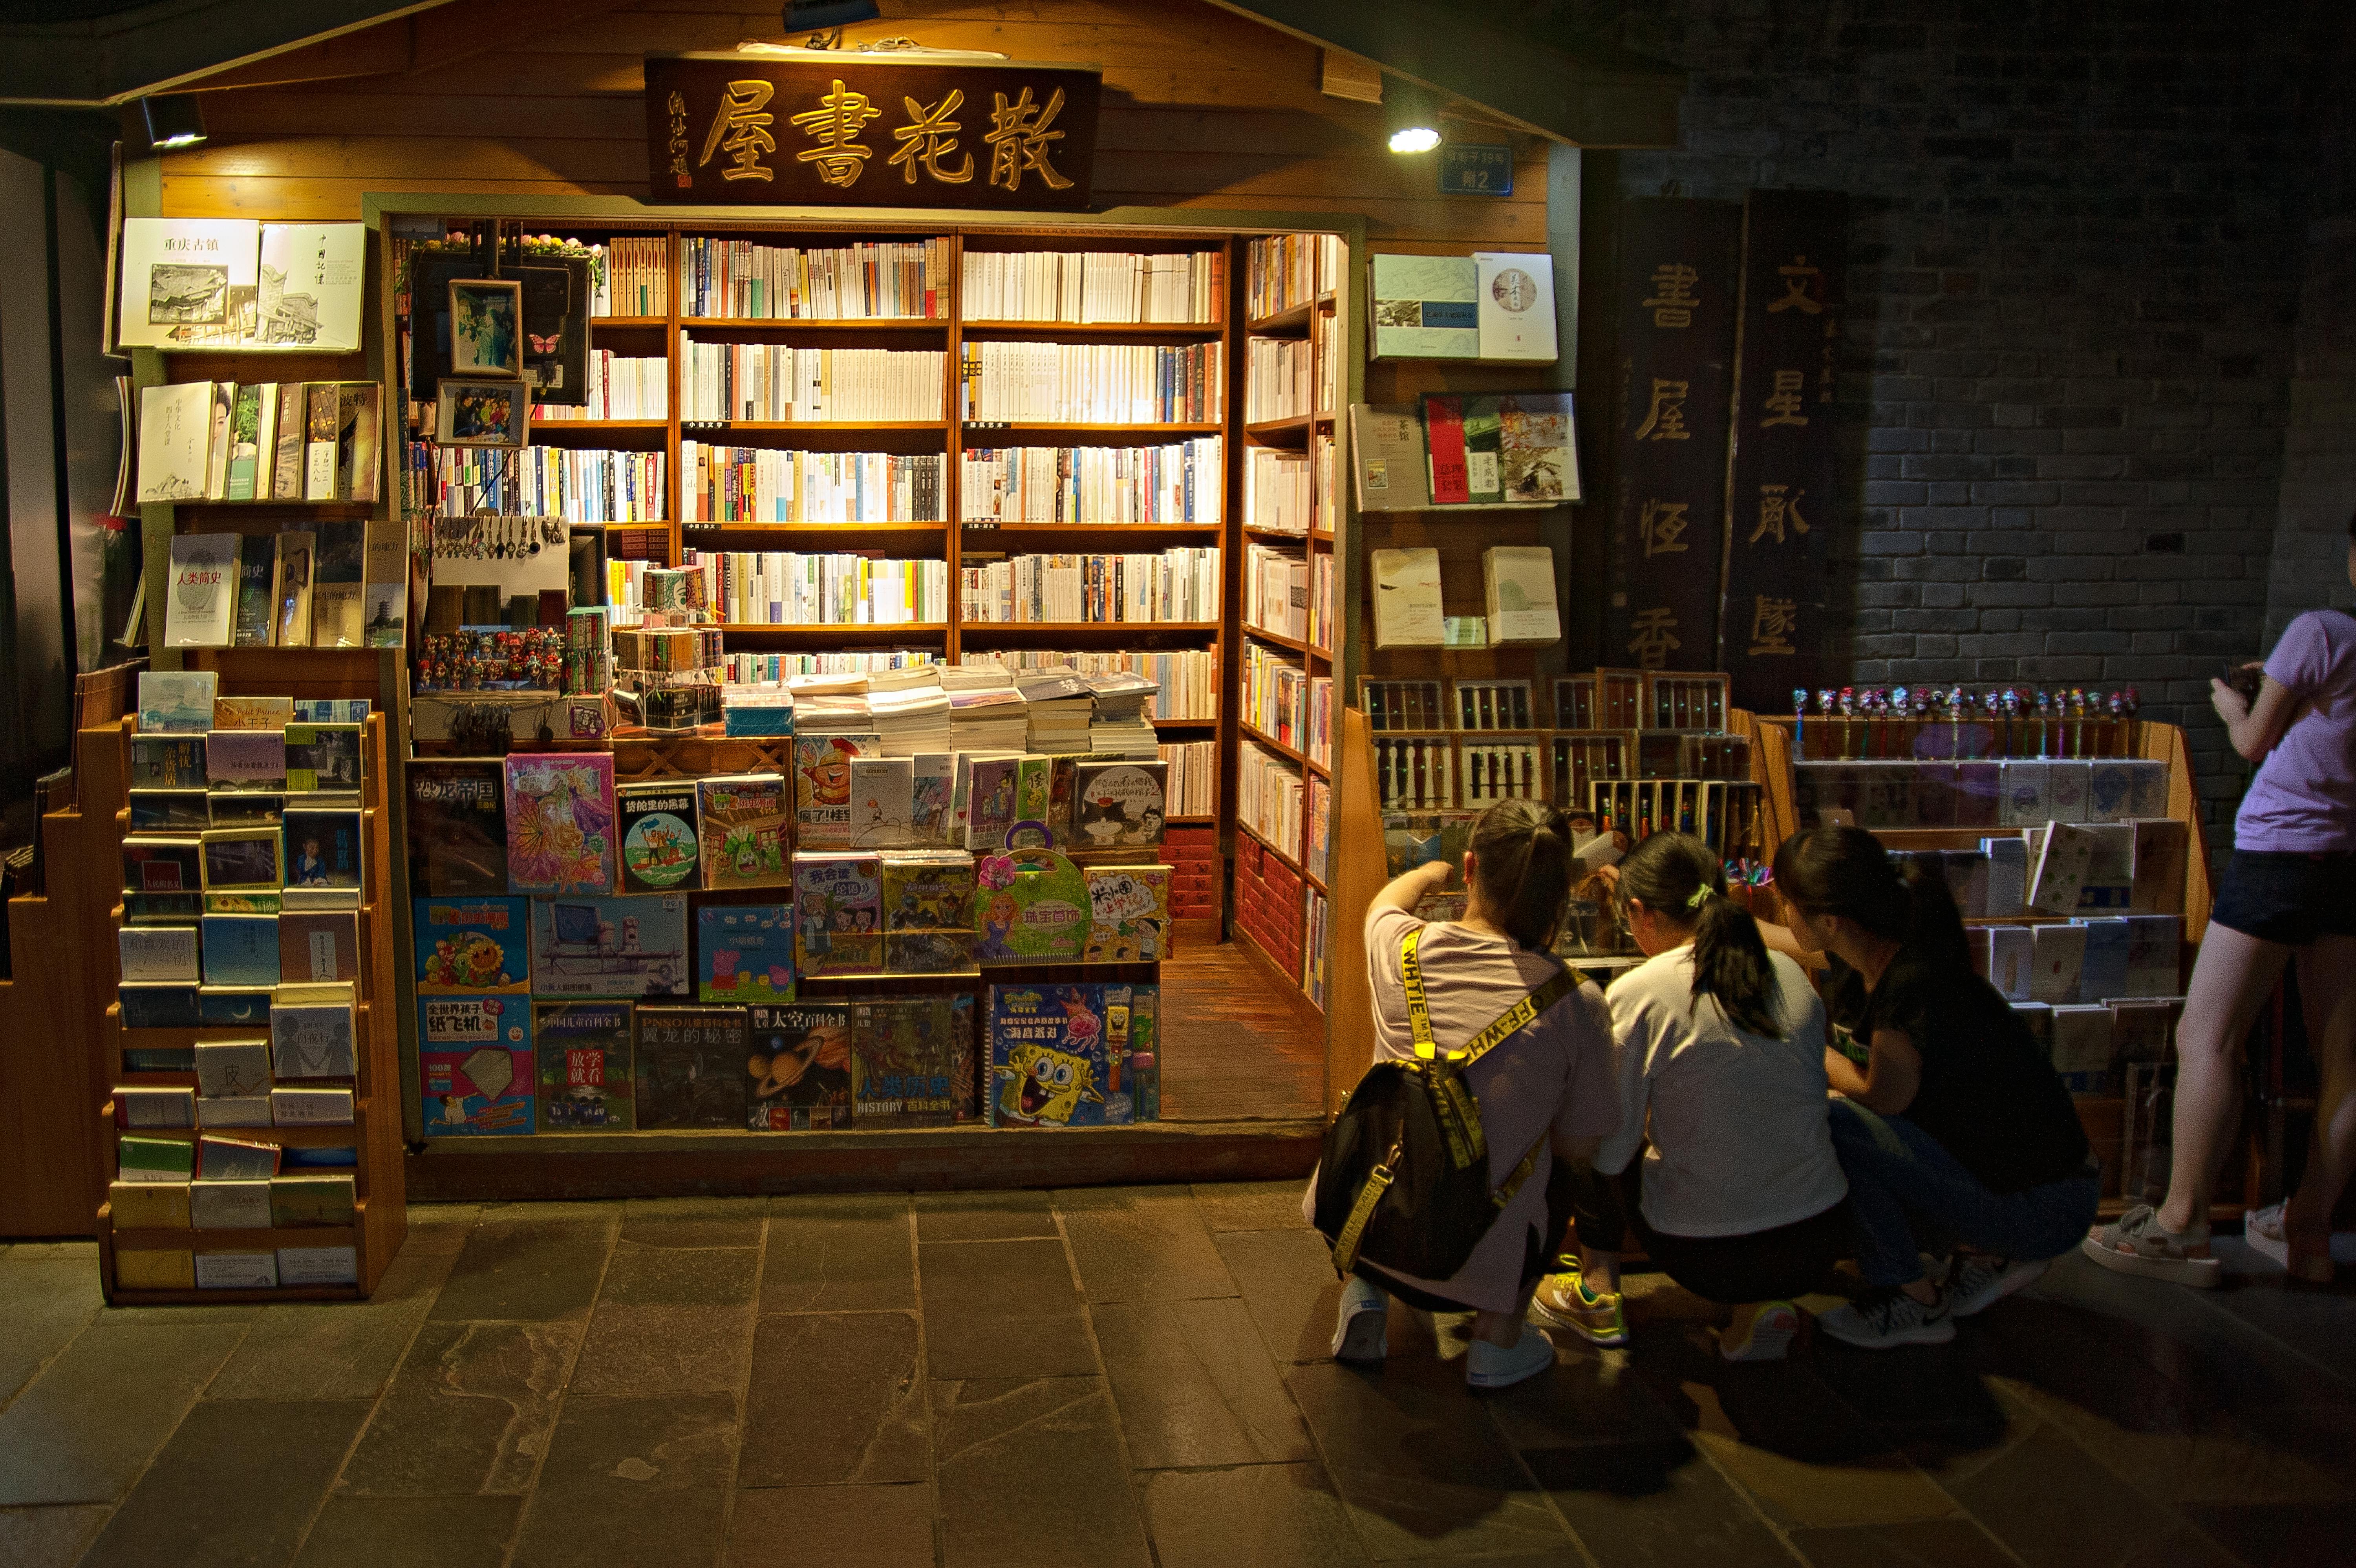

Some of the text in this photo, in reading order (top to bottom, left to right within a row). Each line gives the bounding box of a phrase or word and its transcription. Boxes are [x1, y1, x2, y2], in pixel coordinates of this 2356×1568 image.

[163, 238, 219, 251] 重庆古镇
[177, 571, 221, 585] 人类简史
[626, 798, 689, 813] 货舱里的黑幕
[1025, 909, 1080, 923] 珠宝首饰
[428, 1004, 481, 1015] 全世界孩子
[429, 1015, 481, 1033] 纸飞机
[772, 1010, 845, 1028] 太空百科全书
[642, 1028, 742, 1044] 翼龙的秘密
[571, 1052, 601, 1067] 放学
[571, 1067, 602, 1083] 就看
[857, 1075, 951, 1098] 人类历史
[857, 1101, 902, 1113] HISTORY
[907, 1100, 951, 1112] 百科全书
